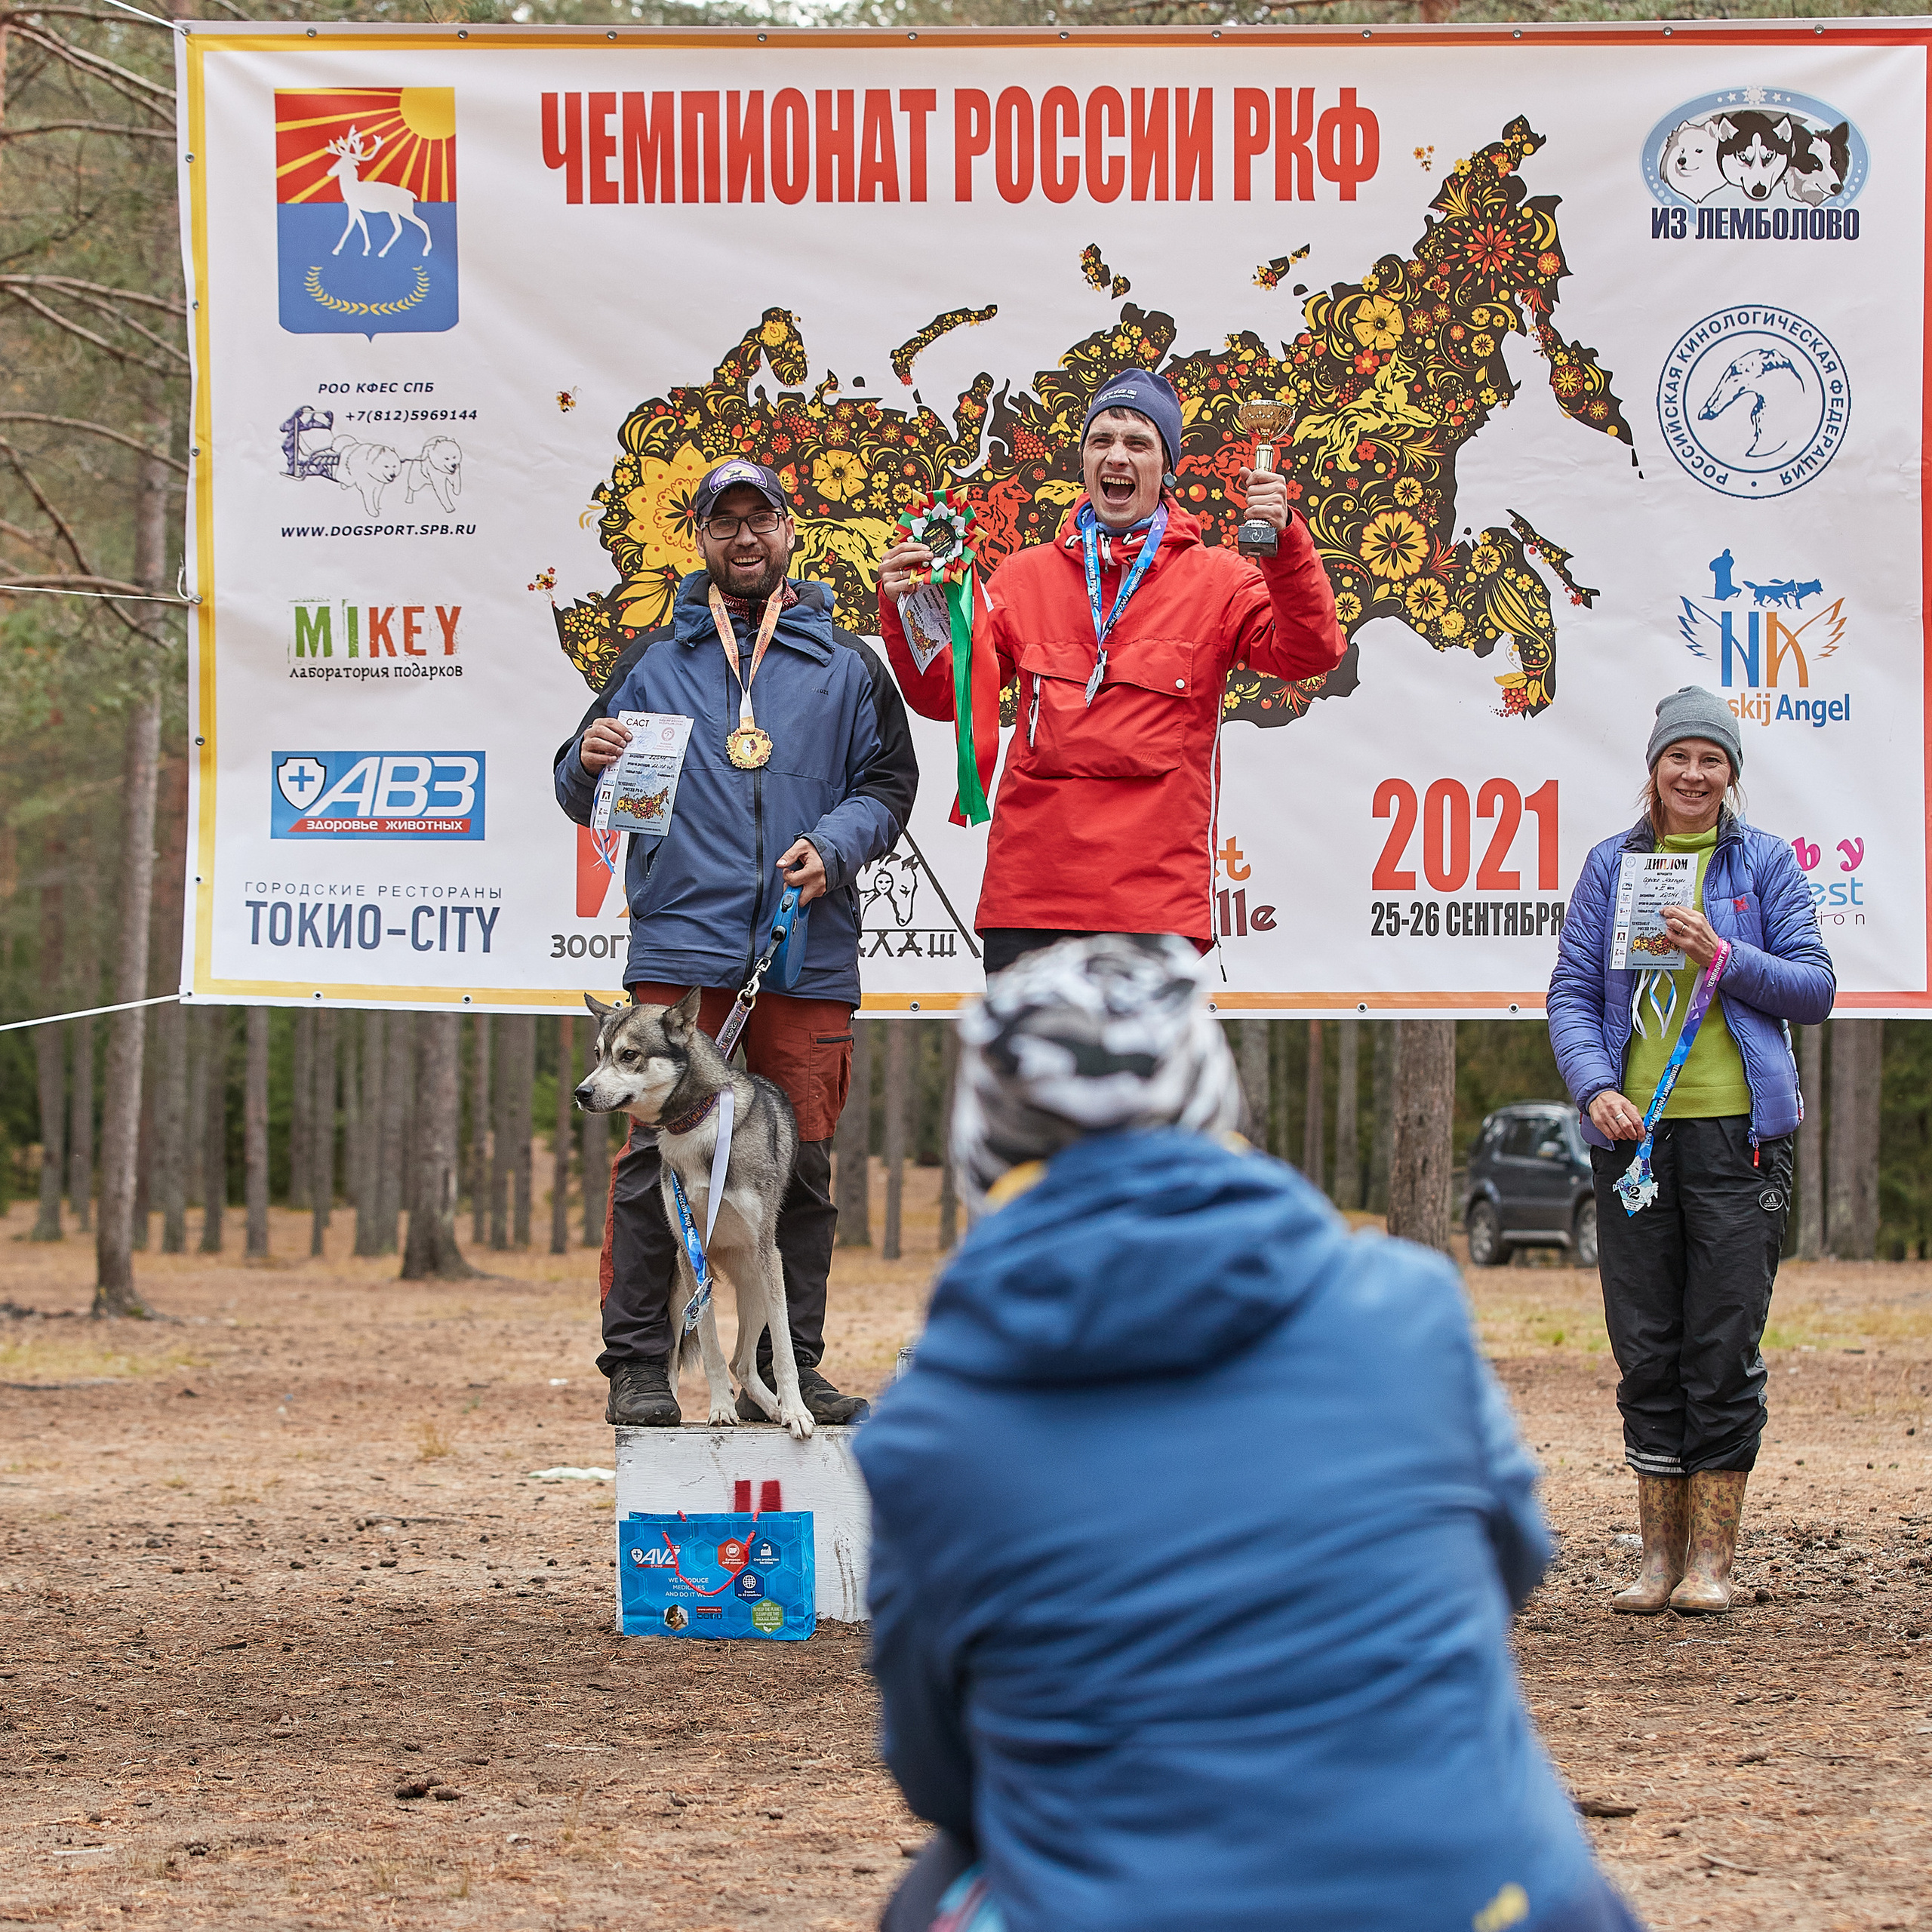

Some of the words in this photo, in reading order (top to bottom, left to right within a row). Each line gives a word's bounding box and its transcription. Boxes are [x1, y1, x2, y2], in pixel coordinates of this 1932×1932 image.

[541, 88, 937, 205] ЧЕМПИОНАТ
[955, 85, 1213, 204] РОССИИ
[1234, 87, 1380, 202] РКФ
[1651, 207, 1687, 239] ИЗ
[1695, 208, 1860, 241] ЛЕМБОЛОВО
[1677, 311, 1838, 374] КИНОЛОГИЧЕСКАЯ
[318, 383, 350, 394] РОО
[356, 382, 398, 393] КФЕС
[404, 382, 434, 393] СПБ
[345, 409, 478, 423] +7(812)5969144
[1664, 367, 1730, 485] РОССИЙСКАЯ
[1780, 379, 1844, 486] ФЕДЕРАЦИЯ
[281, 524, 477, 538] WWW.DOGSPORT.SPB.RU
[294, 605, 463, 659] MIKEY
[289, 665, 389, 681] лаборатория
[394, 662, 463, 678] подарков
[1727, 692, 1770, 727] skij
[1775, 693, 1850, 728] Angel
[304, 755, 480, 817] АВЗ
[1371, 777, 1559, 893] 2021
[1644, 858, 1688, 870] ДИПЛОМ
[1791, 836, 1864, 872] by
[245, 881, 366, 897] ГОРОДСКИЕ
[378, 884, 503, 900] РЕСТОРАНЫ
[1809, 877, 1863, 906] est
[245, 900, 501, 953] ТОКИО-CITY
[1216, 888, 1278, 937] lle
[1371, 901, 1439, 937] 25-26
[1446, 901, 1565, 937] СЕНТЯБРЯ
[1820, 911, 1866, 925] ion
[550, 934, 632, 958] ЗООГ
[1706, 954, 1725, 988] ЧЕМПИОНАТ
[1662, 1064, 1681, 1097] ЧЕМПИОНАТ
[1653, 1096, 1666, 1121] РОССИИ
[678, 1190, 688, 1213] РОССИИ
